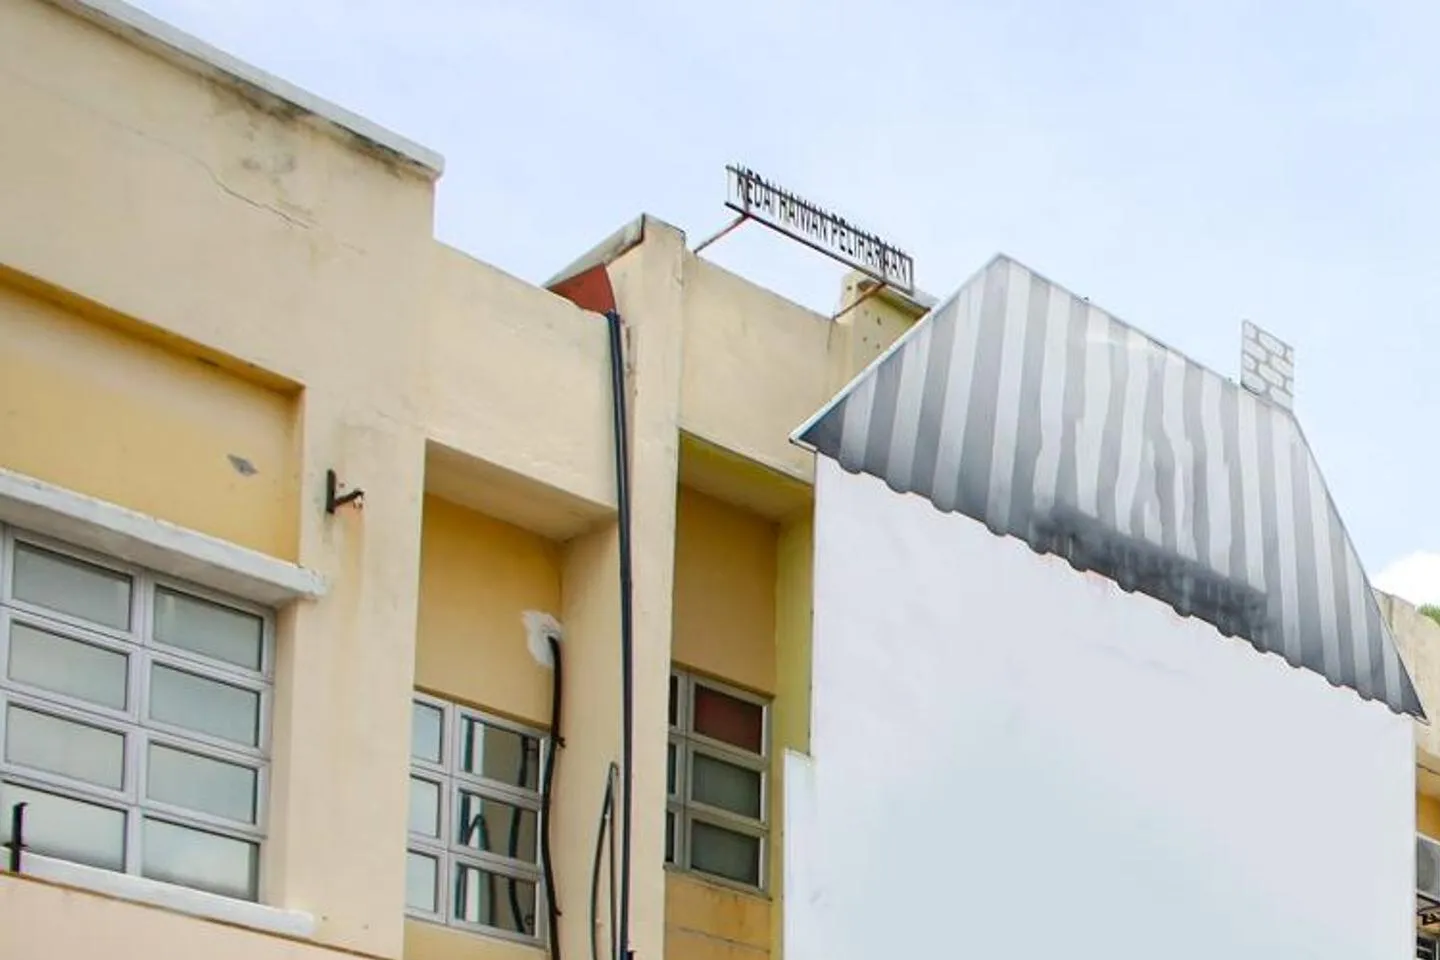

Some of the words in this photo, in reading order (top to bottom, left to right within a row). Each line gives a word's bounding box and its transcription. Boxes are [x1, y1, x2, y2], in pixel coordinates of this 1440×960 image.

[736, 162, 776, 217] KEDAI
[778, 184, 829, 244] HAIWAN
[830, 212, 908, 285] PELIHARAAN
